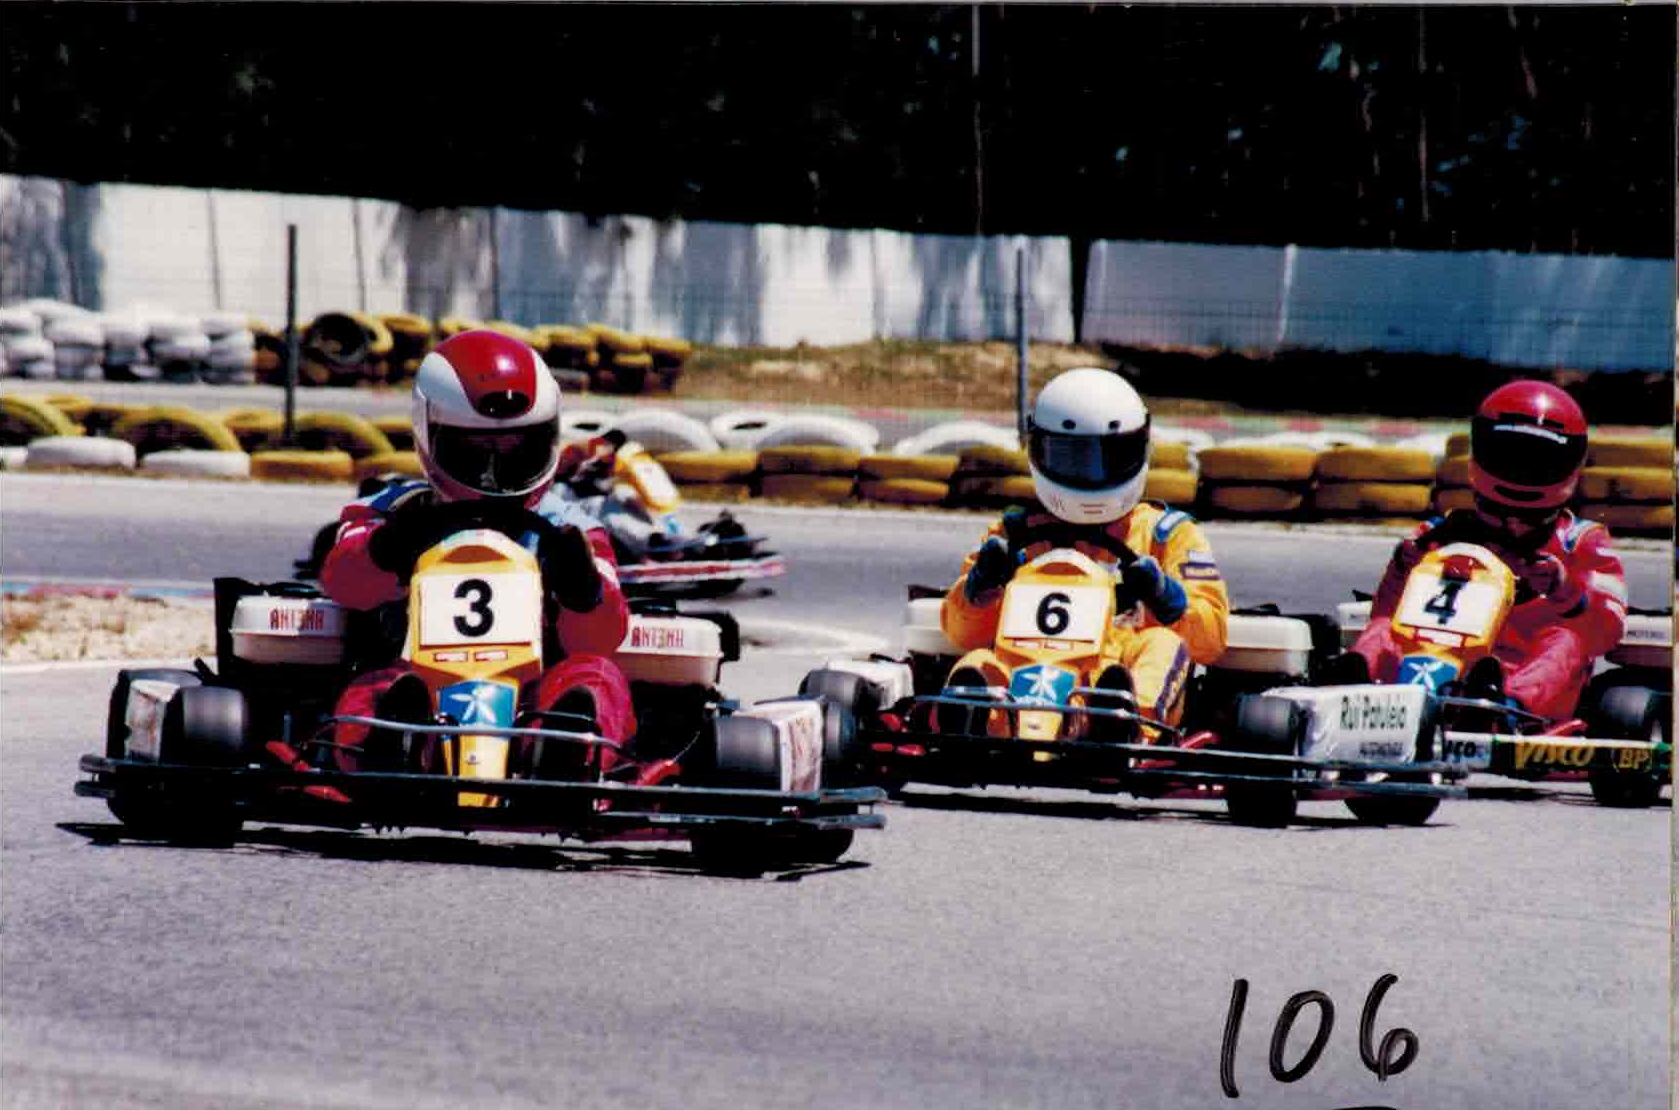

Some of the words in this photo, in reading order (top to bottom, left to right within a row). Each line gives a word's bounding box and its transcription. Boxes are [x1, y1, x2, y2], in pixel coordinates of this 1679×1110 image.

[453, 578, 494, 637] 3
[1035, 592, 1071, 635] 6
[1423, 576, 1469, 625] 4
[1220, 973, 1419, 1099] 106
